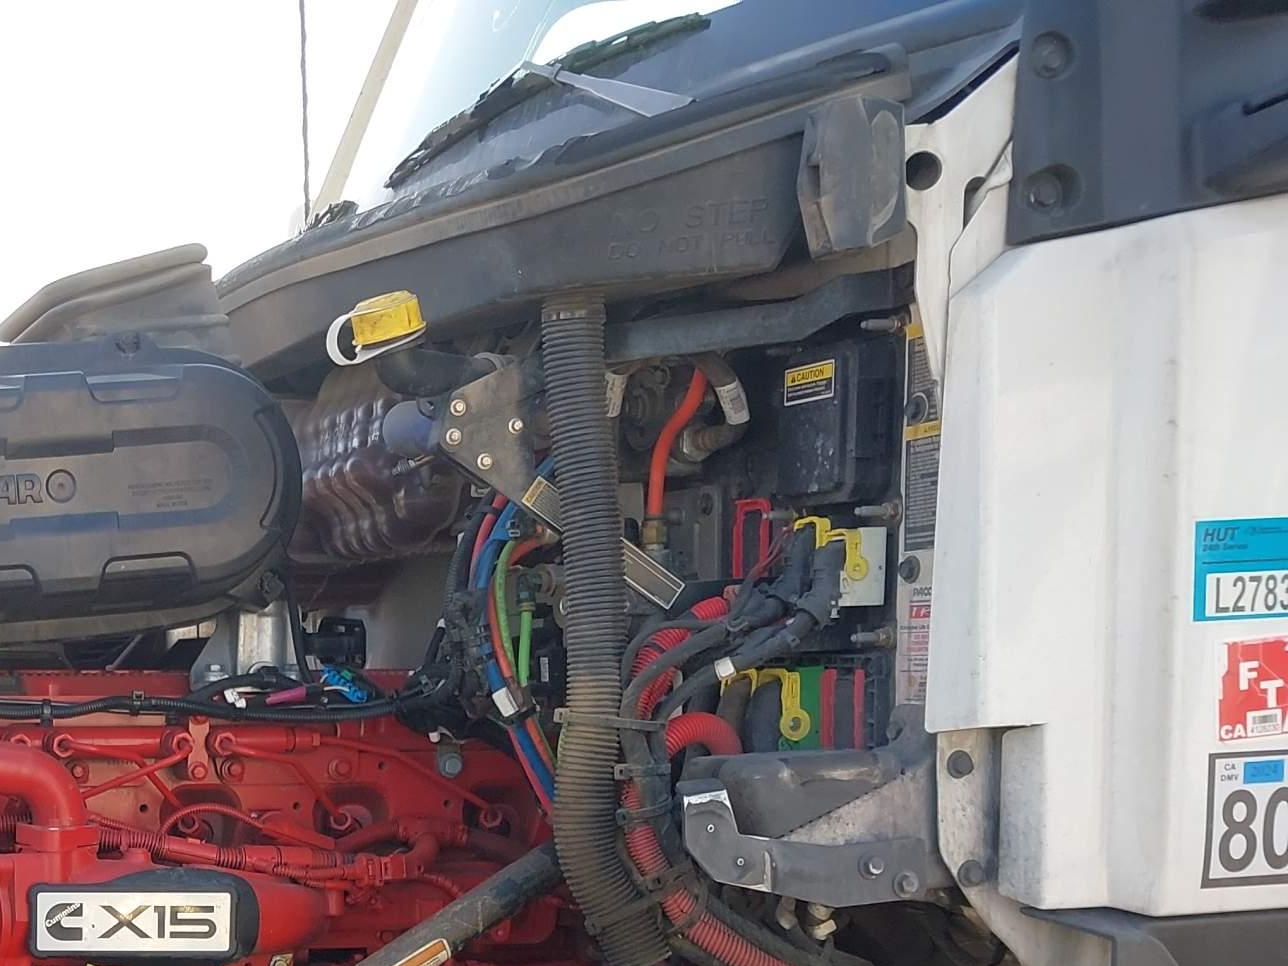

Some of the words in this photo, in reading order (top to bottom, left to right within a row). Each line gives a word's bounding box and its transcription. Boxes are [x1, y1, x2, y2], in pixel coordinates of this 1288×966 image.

[685, 198, 769, 229] STEP
[796, 367, 825, 382] CAUTION
[1203, 526, 1240, 542] HUT
[1220, 773, 1239, 782] DMV
[46, 902, 82, 929] Cummins
[97, 905, 217, 939] X15
